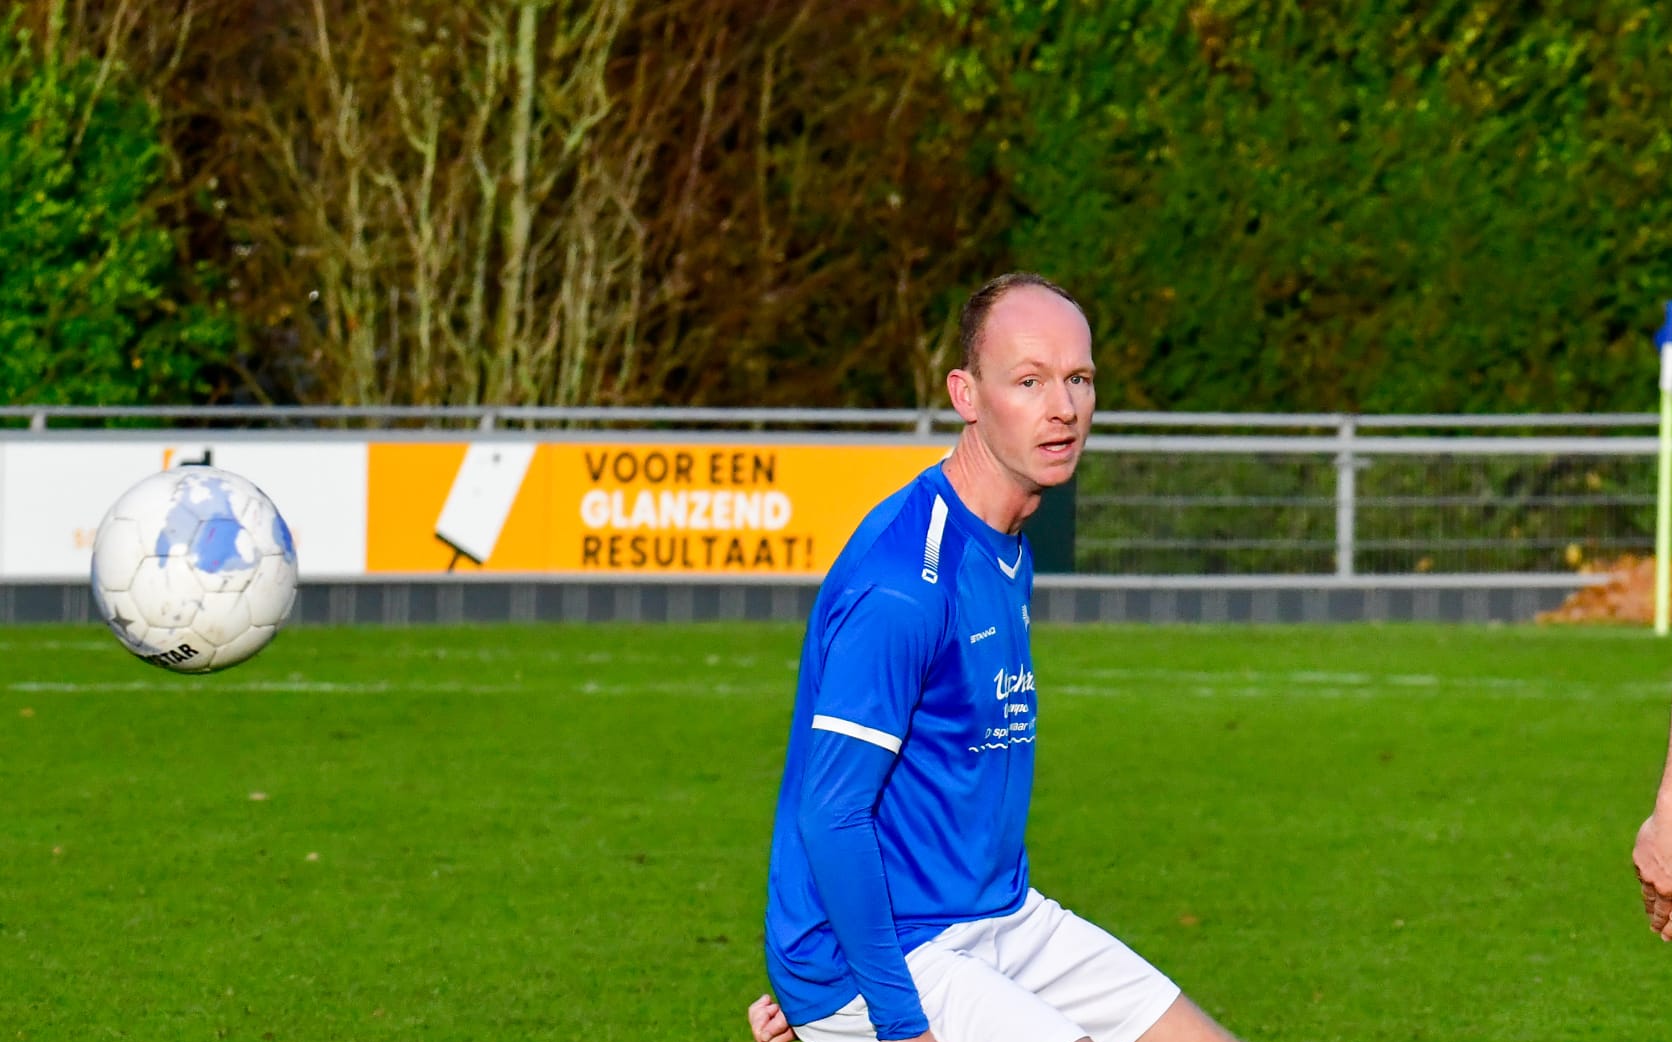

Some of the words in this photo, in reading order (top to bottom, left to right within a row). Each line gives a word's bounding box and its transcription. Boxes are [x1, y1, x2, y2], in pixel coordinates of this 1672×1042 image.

[584, 451, 694, 484] VOOR
[709, 452, 776, 485] EEN
[580, 488, 793, 531] GLANZEND
[581, 535, 815, 569] RESULTAAT!
